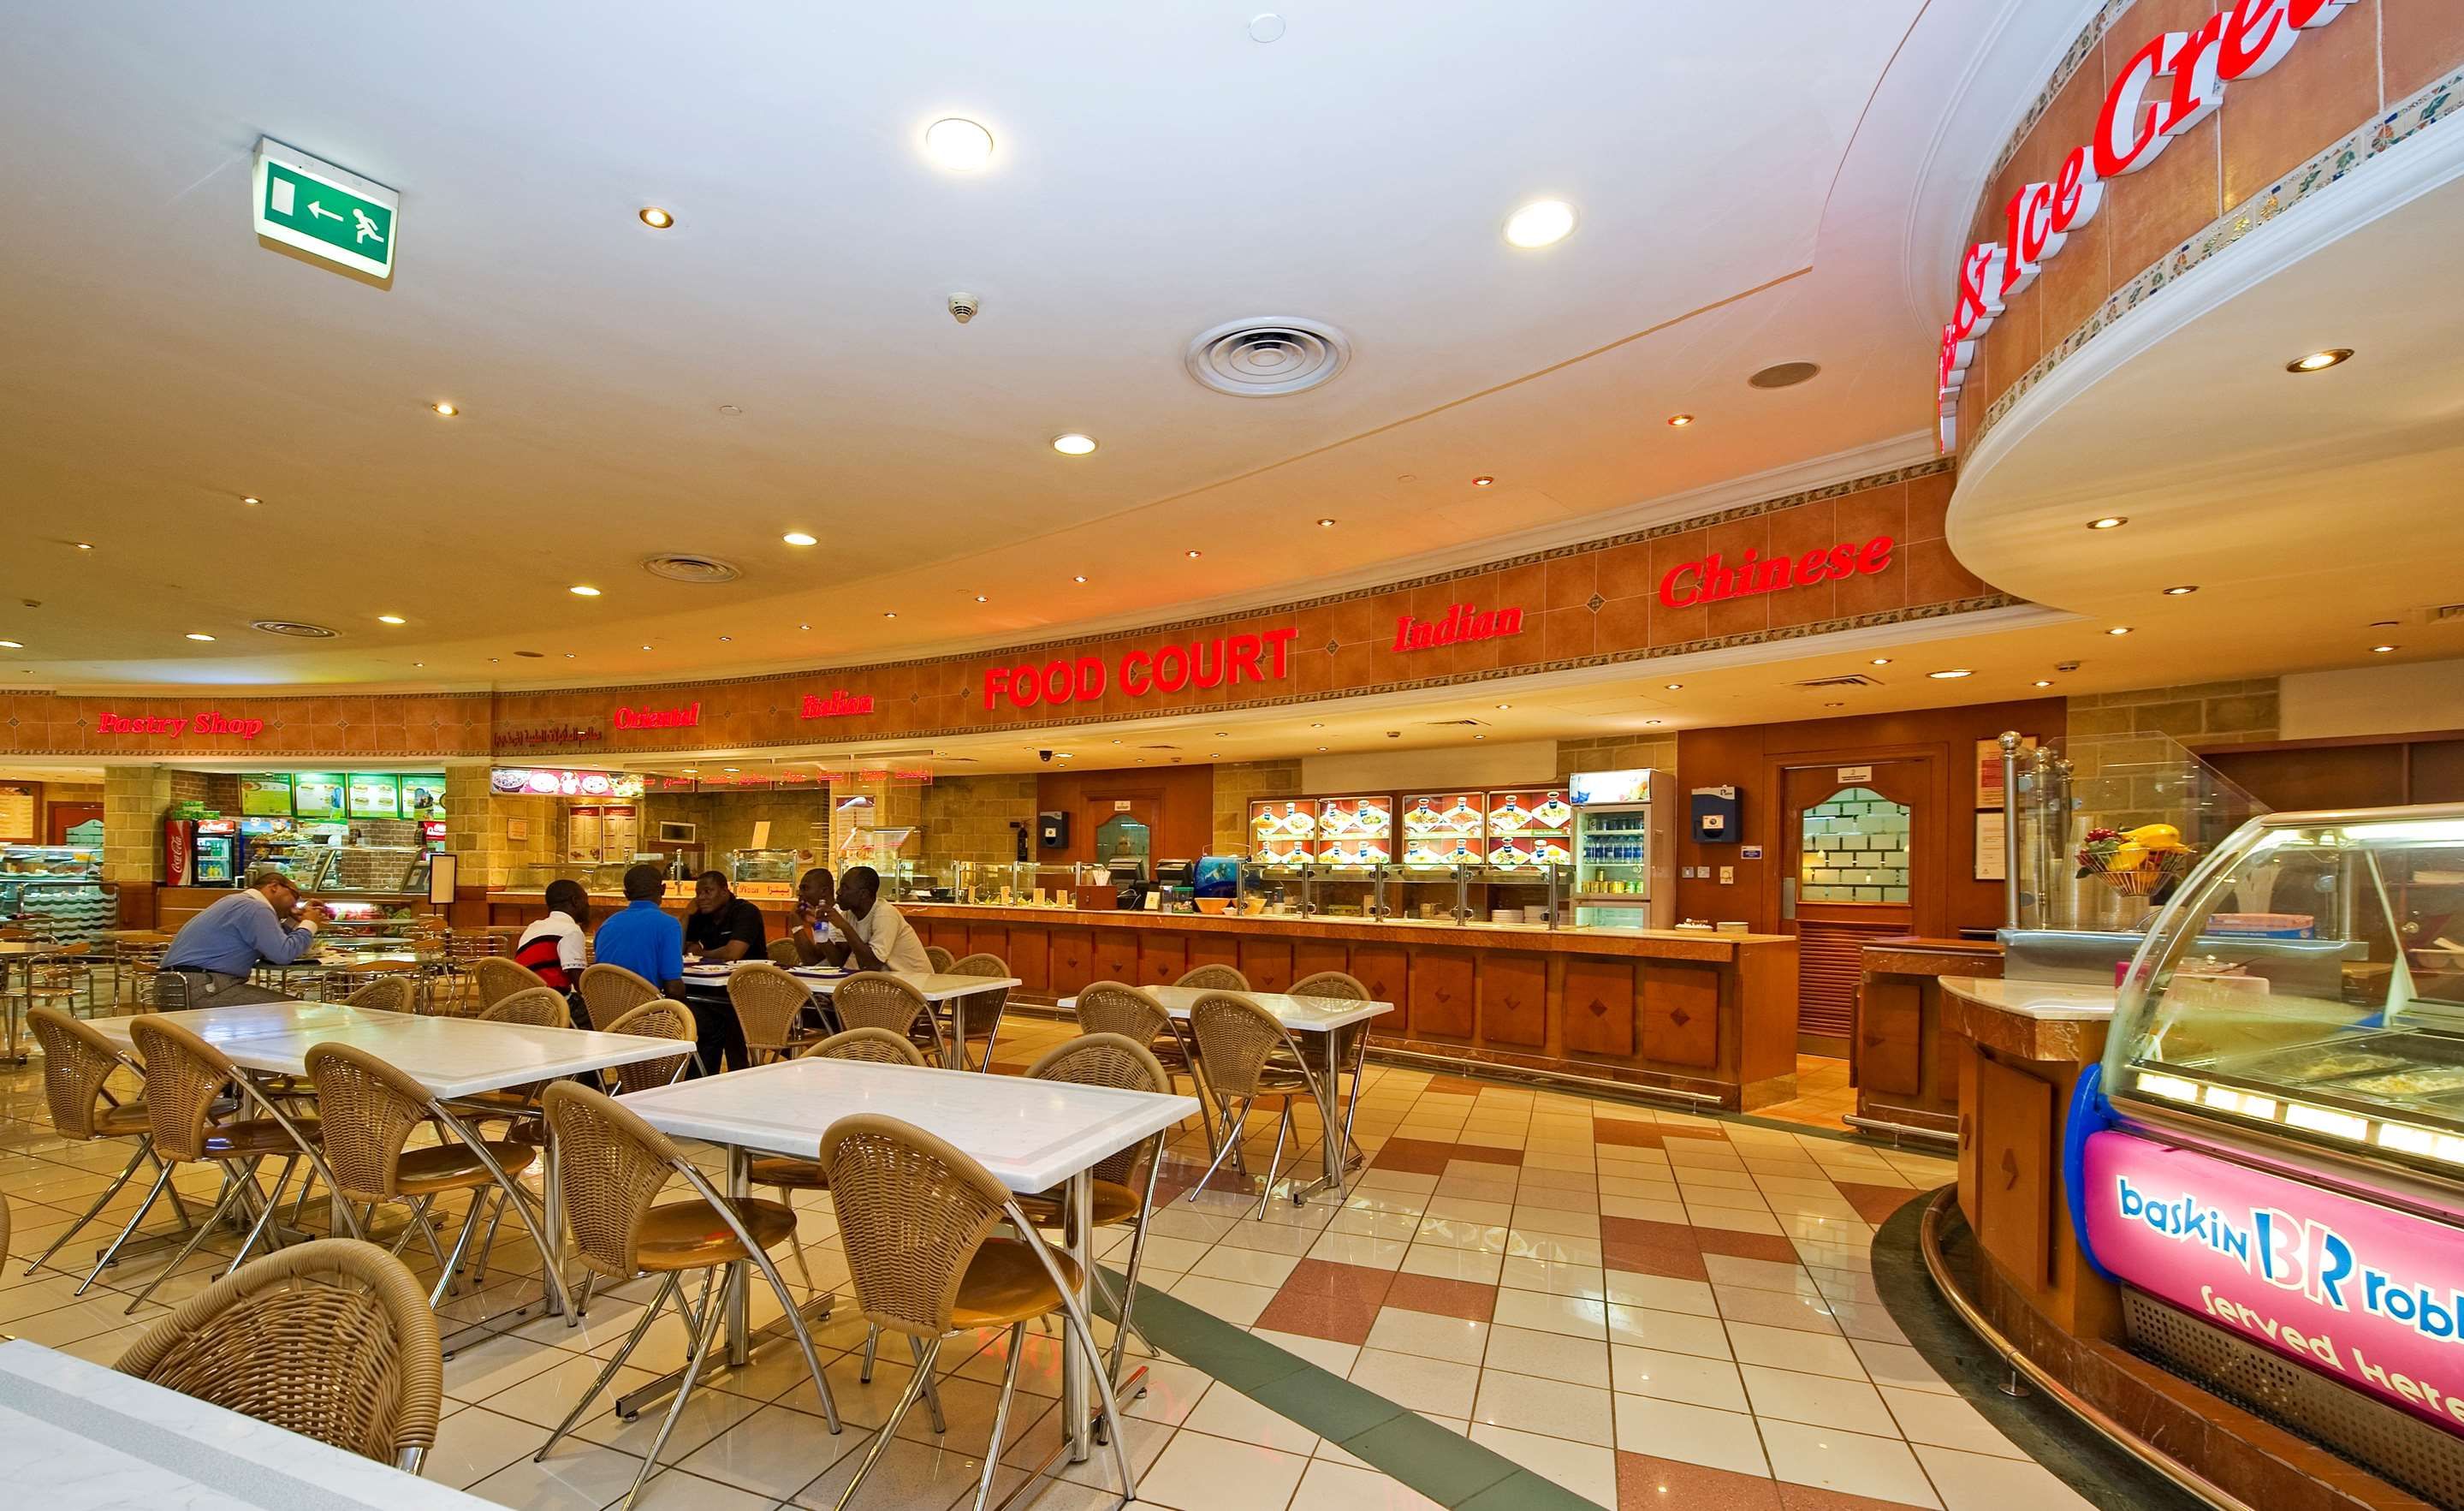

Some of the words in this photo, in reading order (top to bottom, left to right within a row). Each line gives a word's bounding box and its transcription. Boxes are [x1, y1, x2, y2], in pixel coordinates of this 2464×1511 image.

[1952, 242, 2006, 341] &
[2000, 146, 2105, 296] Ice
[1659, 536, 1895, 610] Chinese
[1392, 604, 1523, 651] Indian
[983, 657, 1107, 711] FOOD
[1118, 628, 1299, 698] COURT
[97, 712, 188, 738] Pastry
[193, 711, 264, 740] Shop
[614, 701, 701, 730] Oriental
[2117, 1175, 2251, 1271] baskin
[2200, 1285, 2347, 1371] Served
